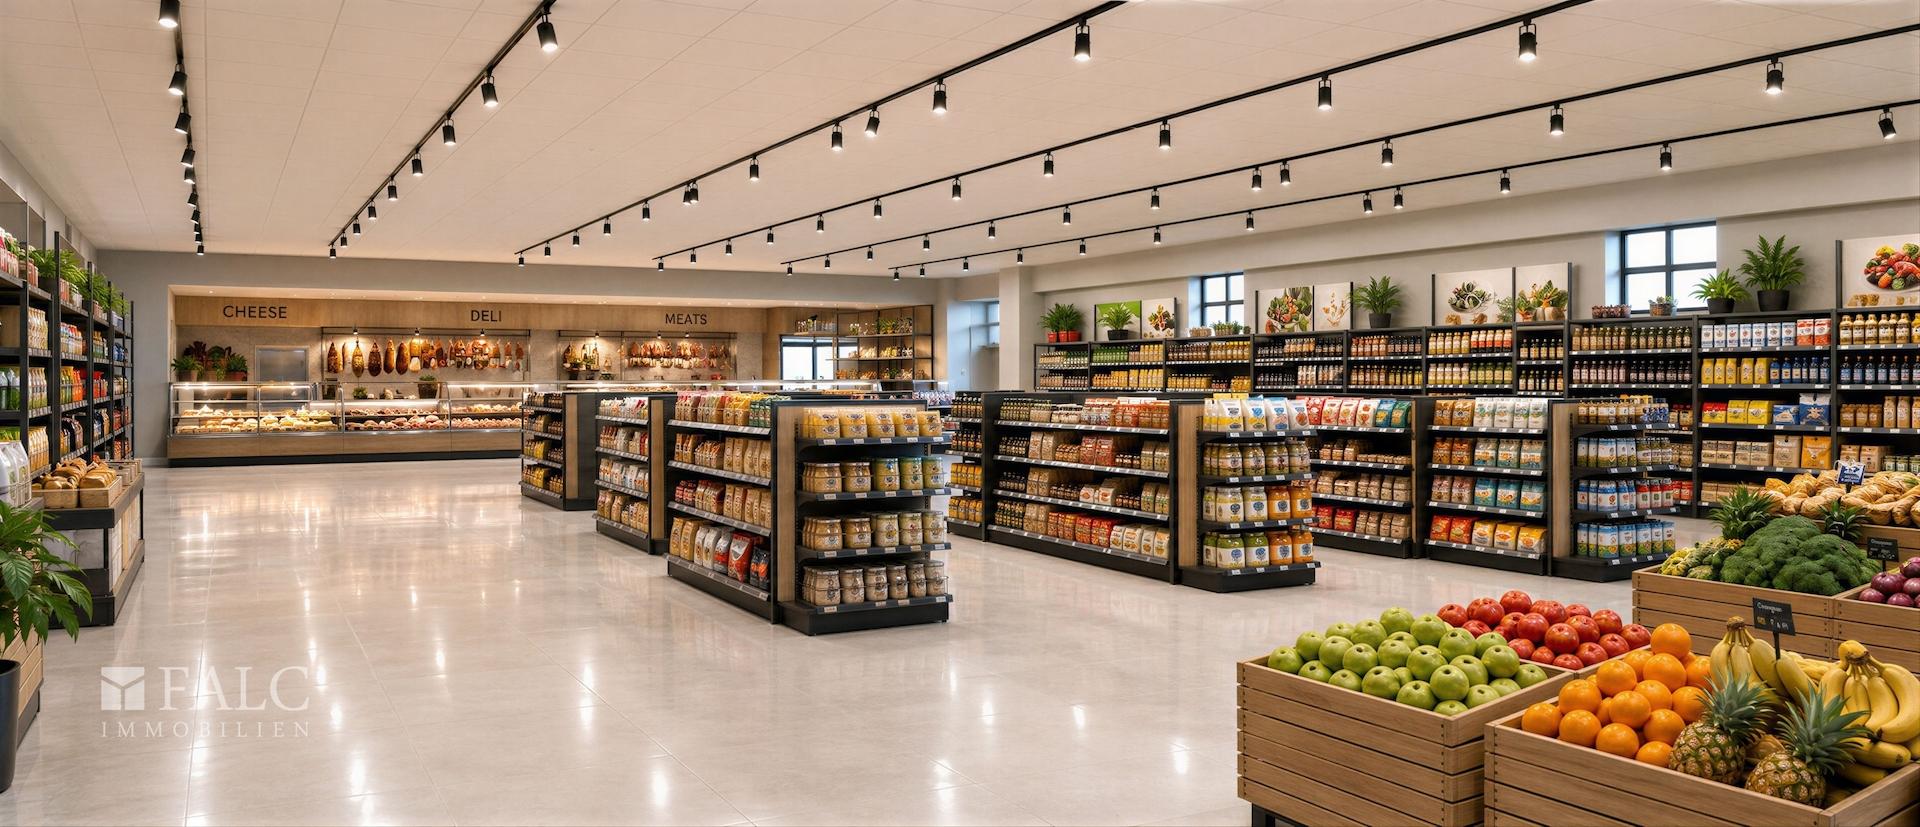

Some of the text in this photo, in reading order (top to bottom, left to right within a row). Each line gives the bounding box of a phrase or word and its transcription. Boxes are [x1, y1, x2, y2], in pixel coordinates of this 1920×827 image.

[223, 305, 287, 318] CHEESE
[471, 309, 501, 322] DELI
[665, 313, 707, 325] MEATS
